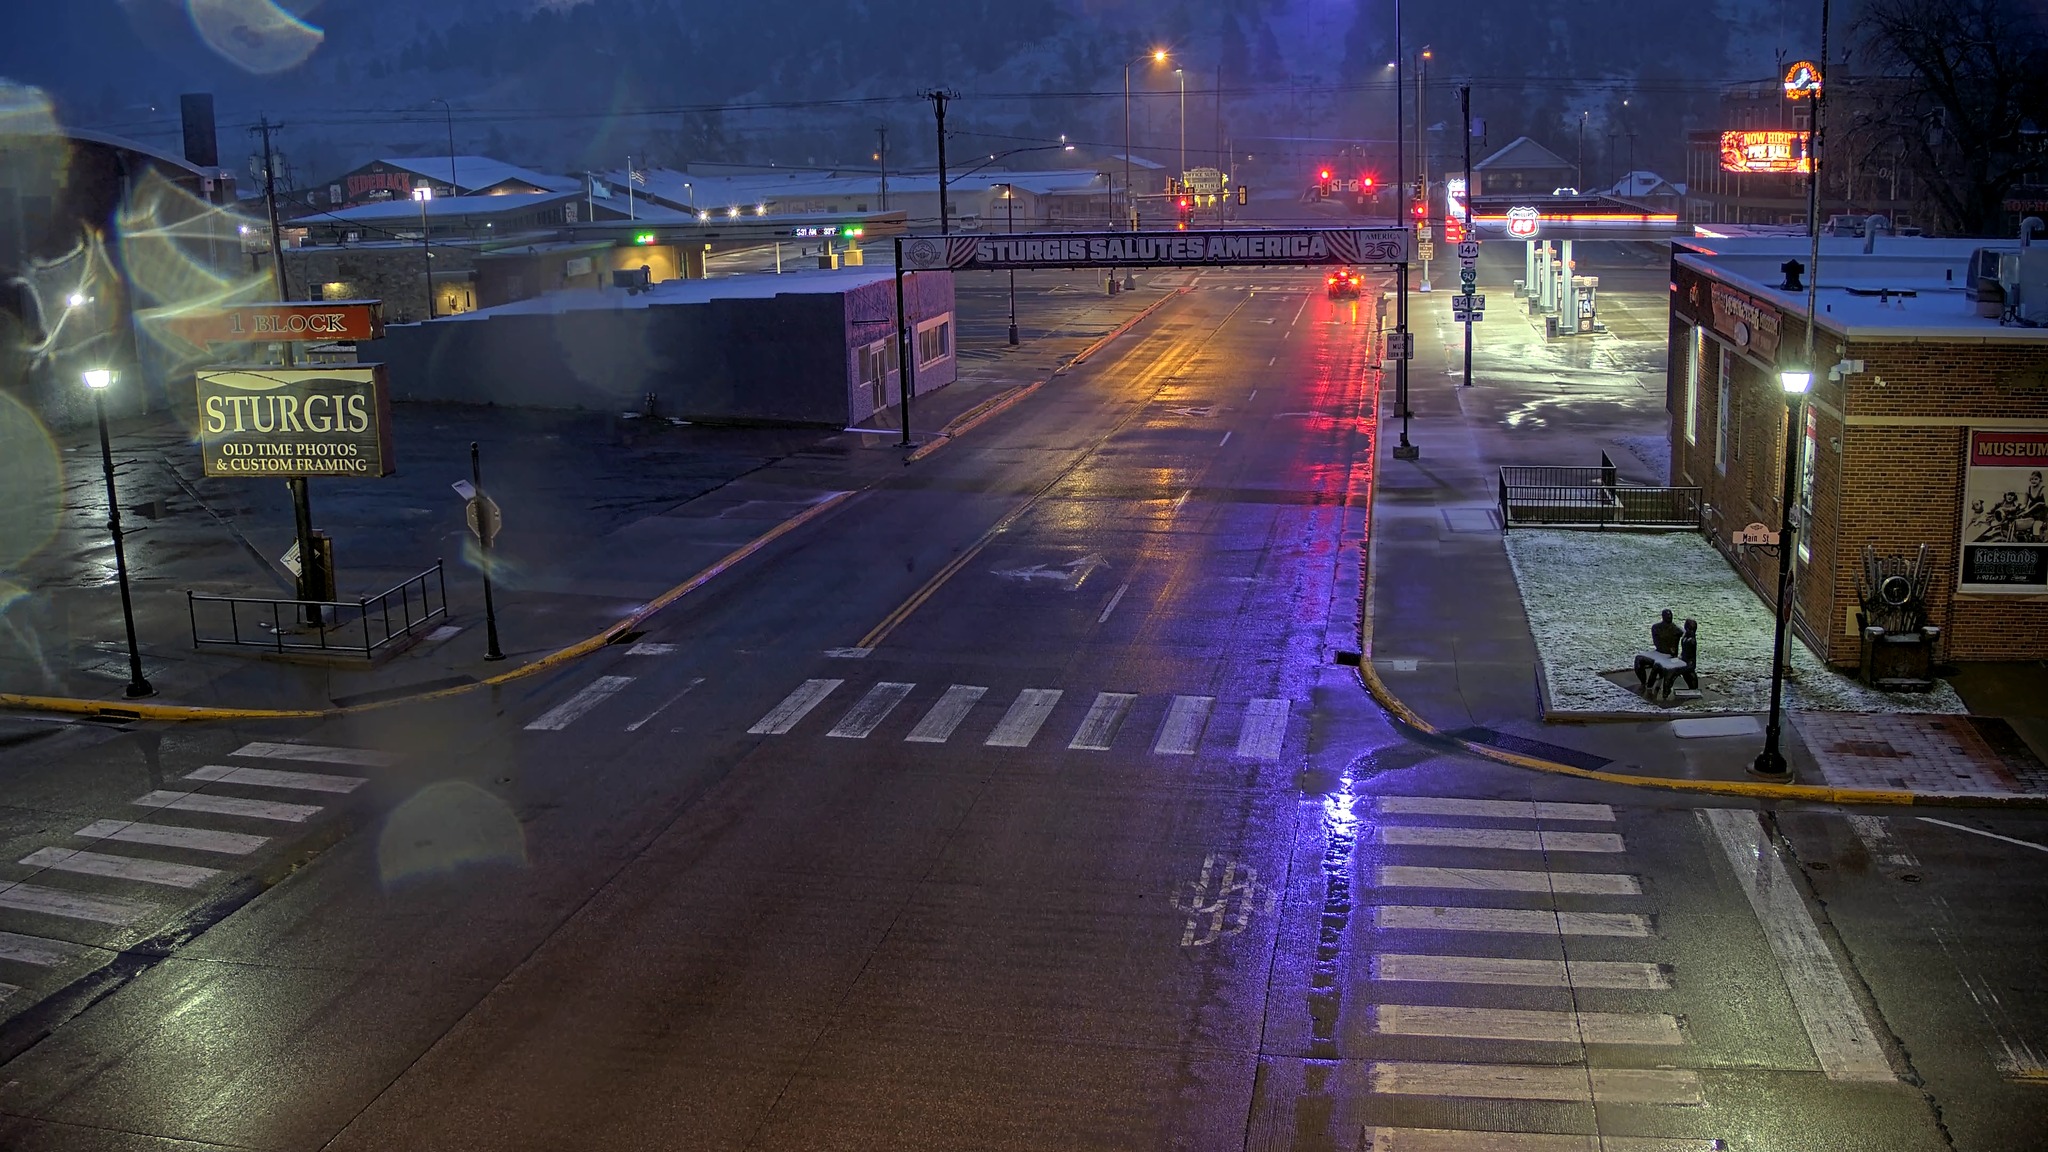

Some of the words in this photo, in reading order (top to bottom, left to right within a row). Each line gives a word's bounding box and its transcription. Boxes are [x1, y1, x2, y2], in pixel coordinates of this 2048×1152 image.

[1744, 132, 1766, 146] NOW
[1365, 232, 1400, 240] AMERICA
[977, 240, 1087, 261] STURGIS
[1089, 238, 1203, 260] SALUTES
[1207, 236, 1327, 259] AMERICA
[1365, 242, 1401, 259] 250
[1462, 272, 1474, 280] 90
[1454, 298, 1467, 308] 34
[1472, 297, 1485, 308] 79
[230, 313, 245, 333] 1
[253, 313, 347, 333] BLOCK
[207, 395, 369, 433] STURGIS
[222, 443, 254, 456] OLD
[256, 443, 294, 456] TIME
[296, 443, 358, 456] PHOTOS
[1978, 442, 2048, 457] MUSEUM
[216, 459, 228, 471] &
[230, 459, 293, 471] CUSTOM
[297, 459, 368, 472] FRAMING
[1743, 533, 1758, 543] Main
[1762, 533, 1770, 543] St
[1975, 549, 2038, 563] Kickstands
